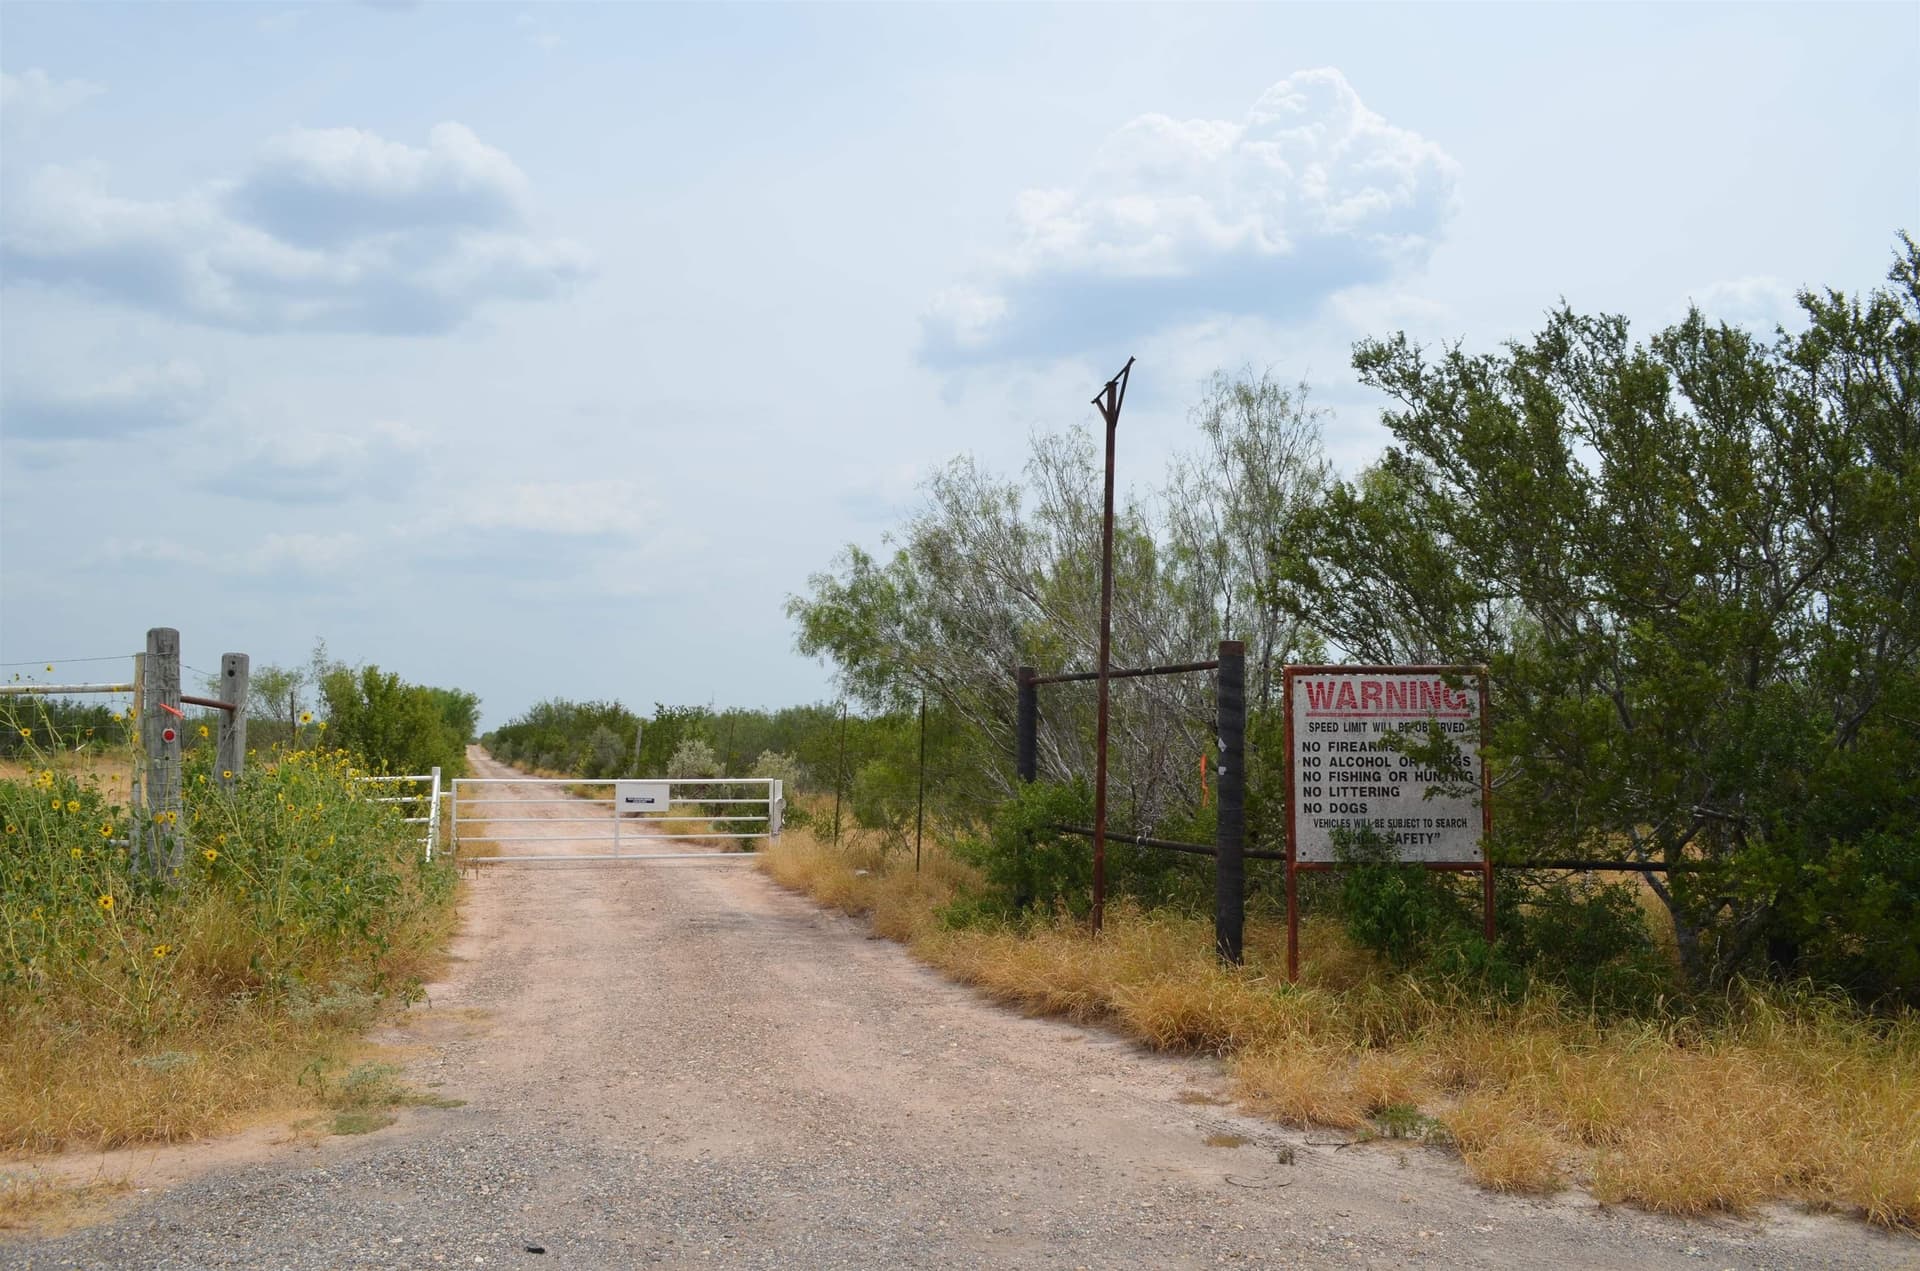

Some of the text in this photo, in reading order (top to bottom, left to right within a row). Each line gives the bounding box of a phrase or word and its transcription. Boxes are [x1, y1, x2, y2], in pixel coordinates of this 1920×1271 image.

[1305, 681, 1467, 710] WARNING
[1309, 722, 1338, 732] SPEED
[1344, 722, 1367, 732] LIMIT
[1416, 722, 1465, 732] OBRVED
[1303, 742, 1398, 752] NO FIREAR
[1303, 757, 1321, 767] NO
[1329, 757, 1391, 767] ALCOHOL
[1303, 772, 1321, 781] NO
[1329, 772, 1381, 782] FISHING
[1389, 772, 1407, 781] OR
[1304, 787, 1400, 797] NO LITTERING
[1304, 803, 1368, 813] NO DOGS
[1314, 819, 1350, 828] VEHICLES
[1375, 819, 1384, 828] BE
[1388, 819, 1420, 828] SUBJECT
[1424, 819, 1433, 828] TO
[1436, 819, 1467, 828] SEARCH
